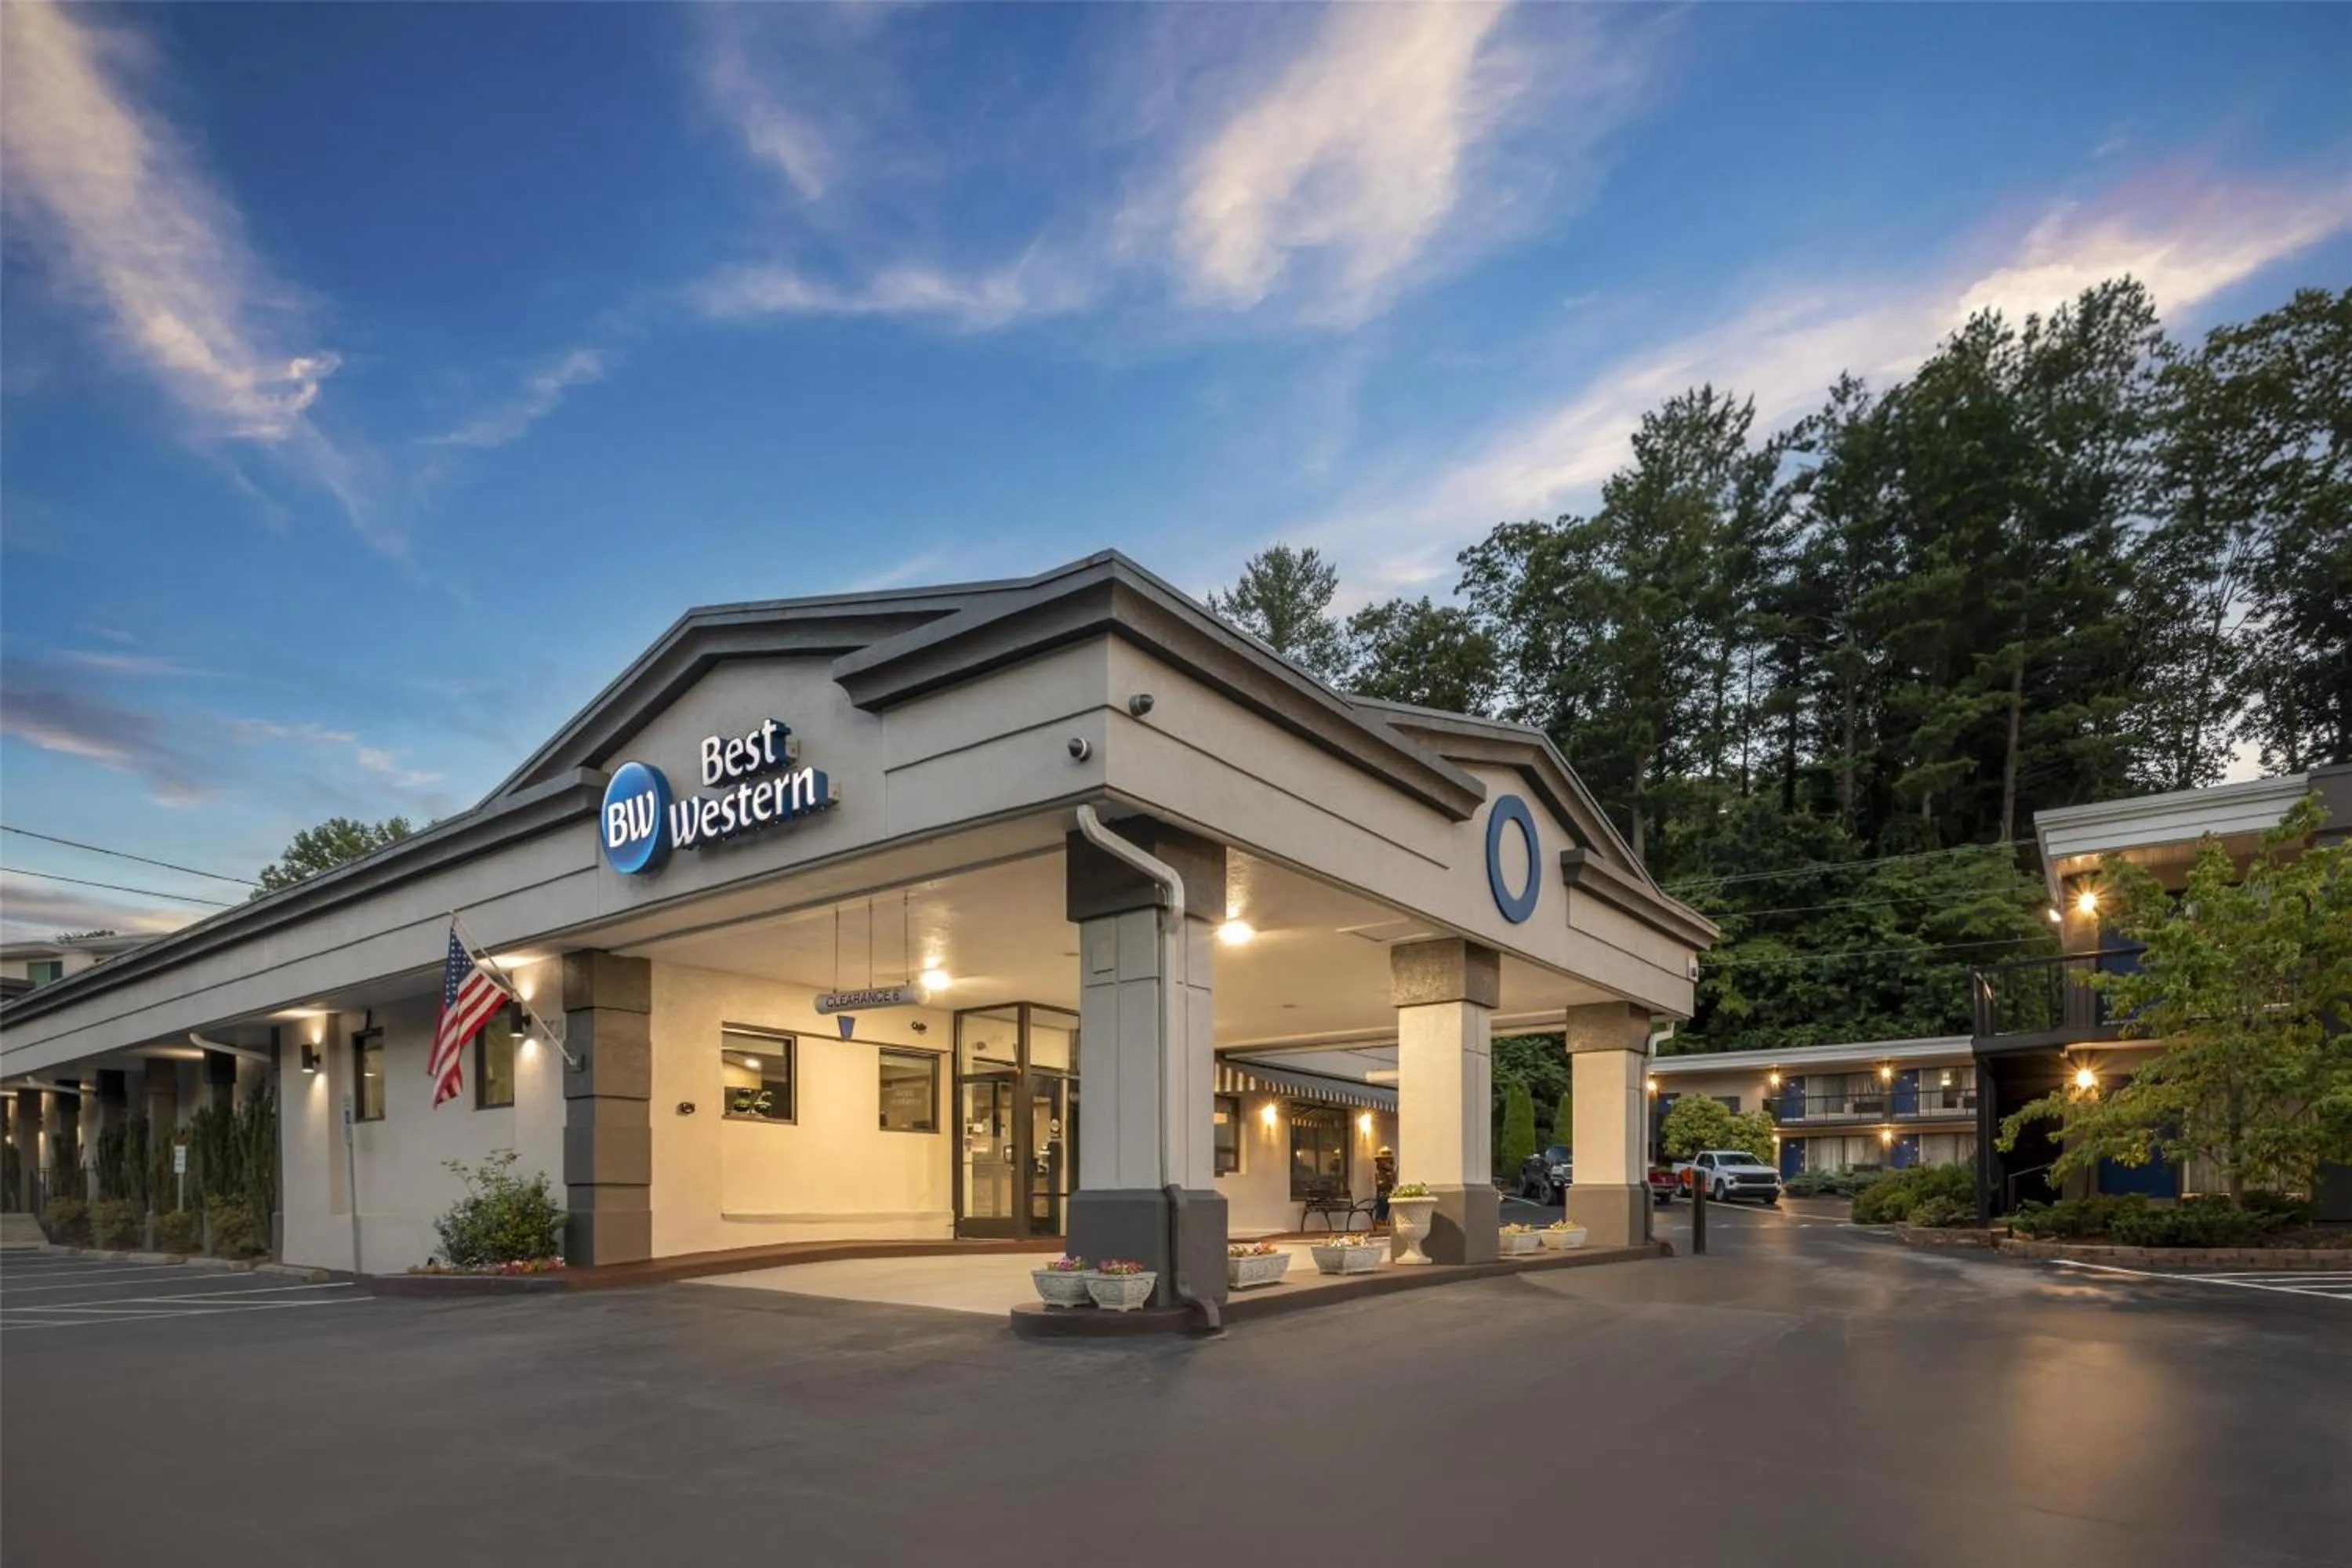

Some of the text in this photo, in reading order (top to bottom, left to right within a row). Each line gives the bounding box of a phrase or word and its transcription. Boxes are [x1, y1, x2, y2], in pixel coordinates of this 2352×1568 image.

[702, 718, 777, 786] Best
[608, 790, 655, 848] BW
[669, 767, 816, 849] Western
[826, 989, 891, 1007] CLEARANCE
